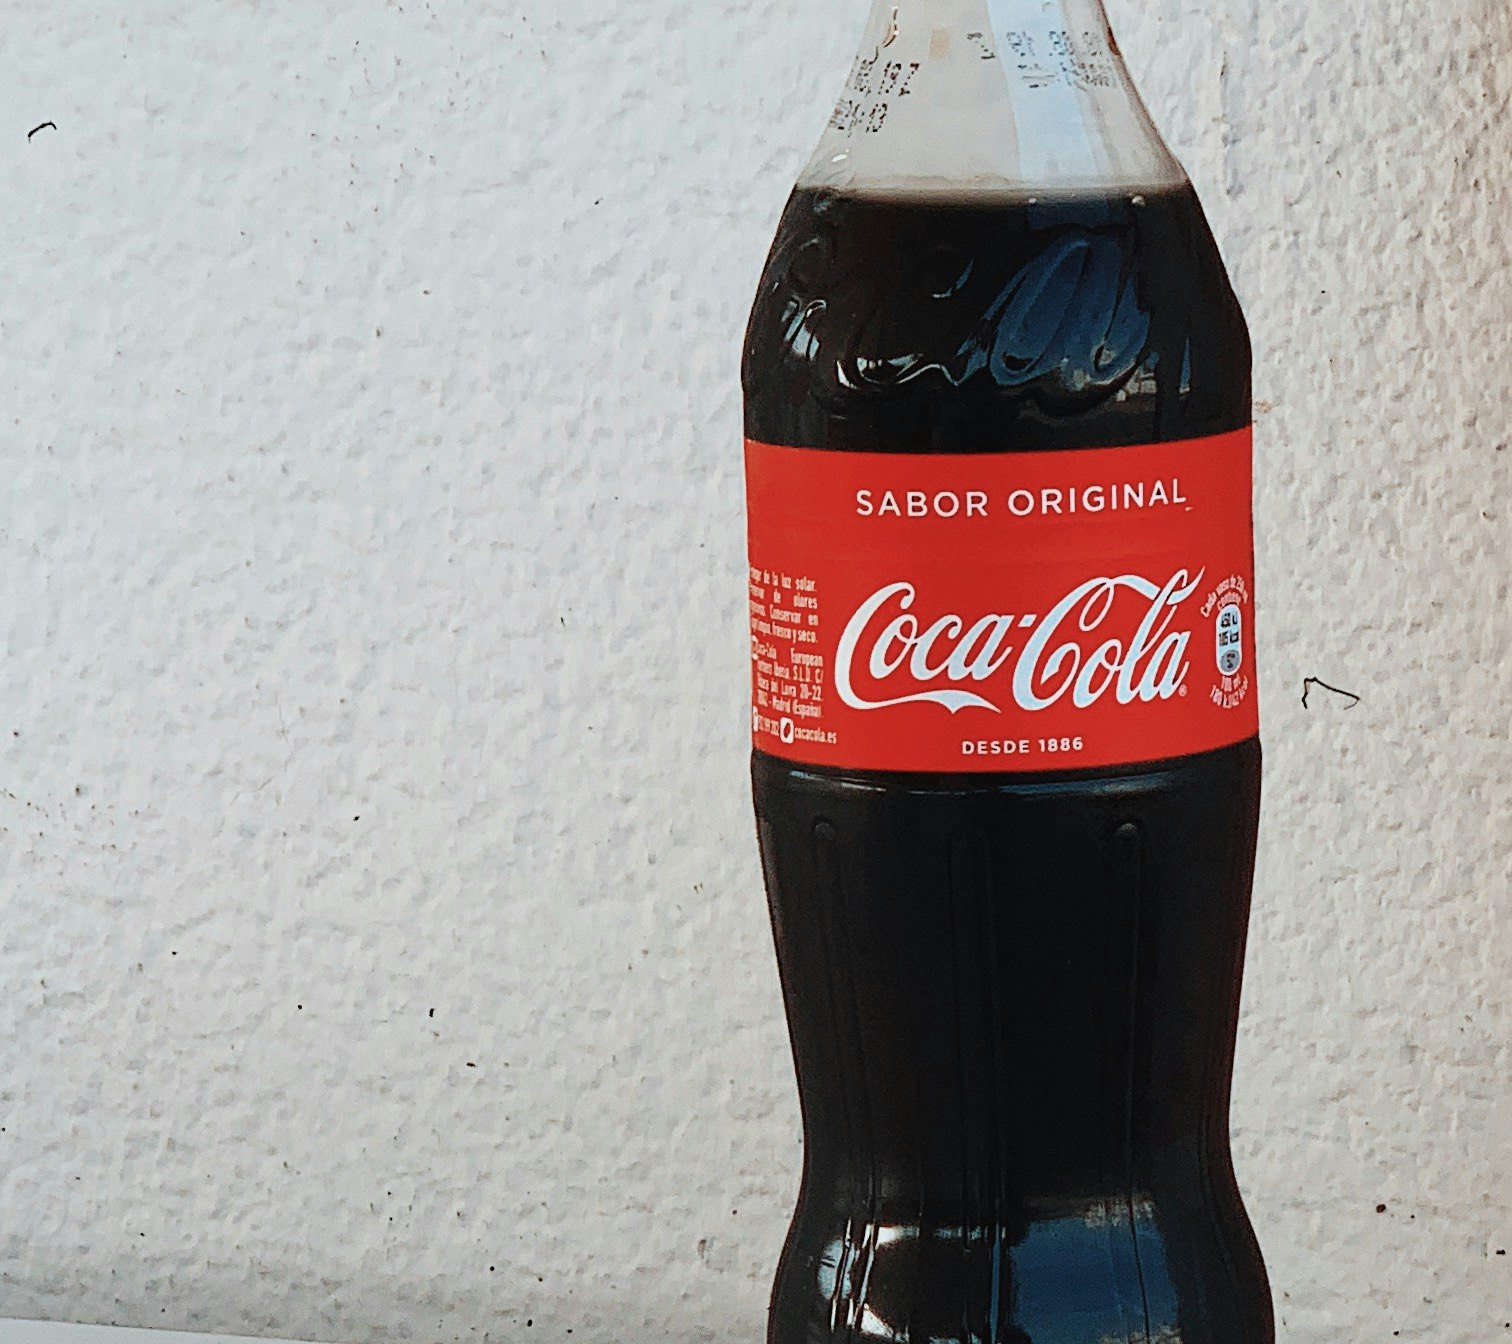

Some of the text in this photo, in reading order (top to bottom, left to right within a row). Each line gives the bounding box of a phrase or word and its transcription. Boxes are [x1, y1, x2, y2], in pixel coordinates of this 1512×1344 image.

[856, 478, 1187, 517] SABOR ORIGINAL
[834, 565, 1206, 714] Coca-Cola
[962, 736, 1083, 754] DESDE 1886
